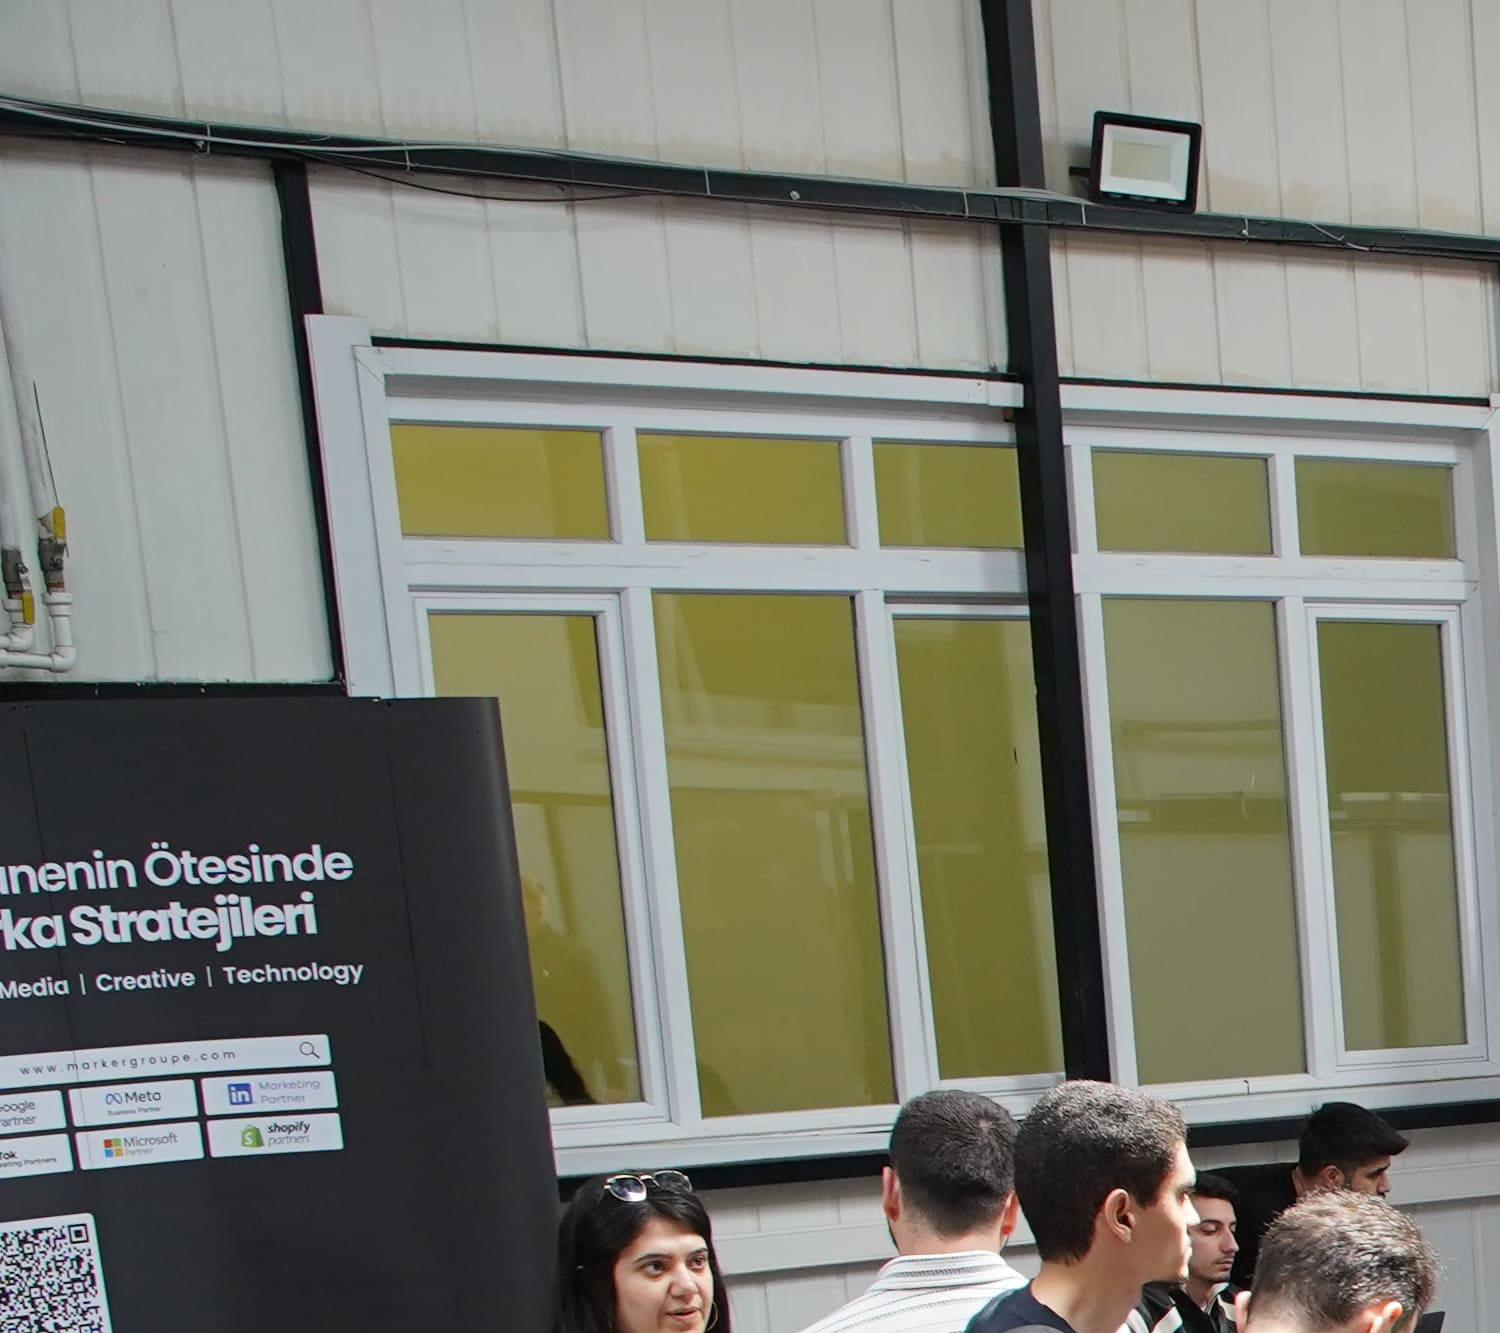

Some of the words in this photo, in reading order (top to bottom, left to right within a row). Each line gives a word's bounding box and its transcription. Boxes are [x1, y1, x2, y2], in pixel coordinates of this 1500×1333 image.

[144, 841, 354, 887] Ötesinde
[69, 890, 318, 952] Stratejileri
[0, 977, 70, 1000] Media
[95, 968, 196, 992] Creative
[222, 962, 364, 986] Technology
[258, 1079, 321, 1091] Marketing
[124, 1091, 162, 1104] Meta
[260, 1094, 307, 1105] Partner
[267, 1121, 311, 1135] shopify
[123, 1132, 179, 1148] Microsoft
[268, 1134, 311, 1147] partners
